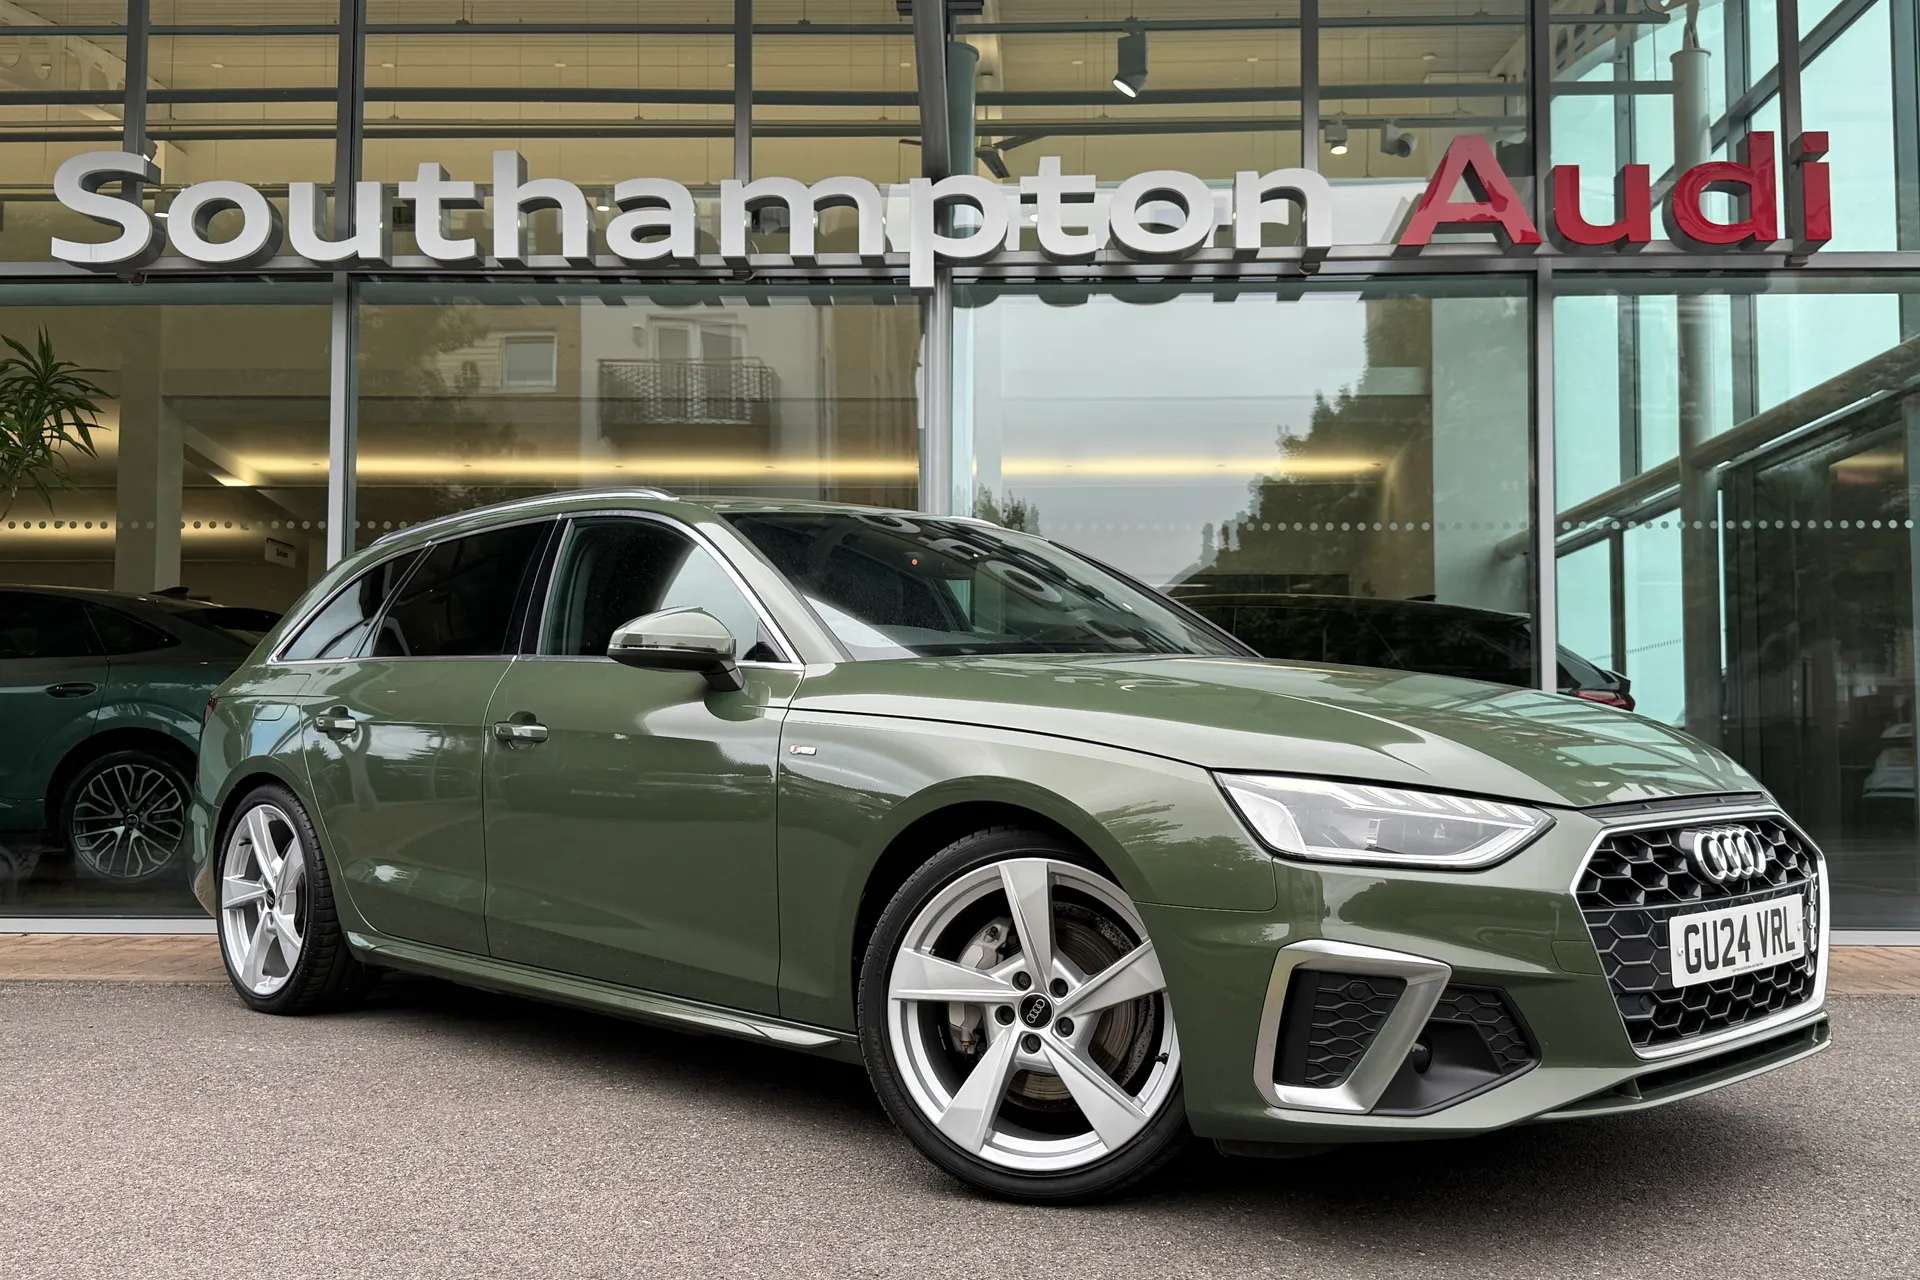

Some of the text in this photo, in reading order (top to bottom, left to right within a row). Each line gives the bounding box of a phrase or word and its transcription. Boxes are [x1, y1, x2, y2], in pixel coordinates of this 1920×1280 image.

[51, 131, 1832, 288] Southampton Audi
[1684, 906, 1796, 975] GU24 VRL
